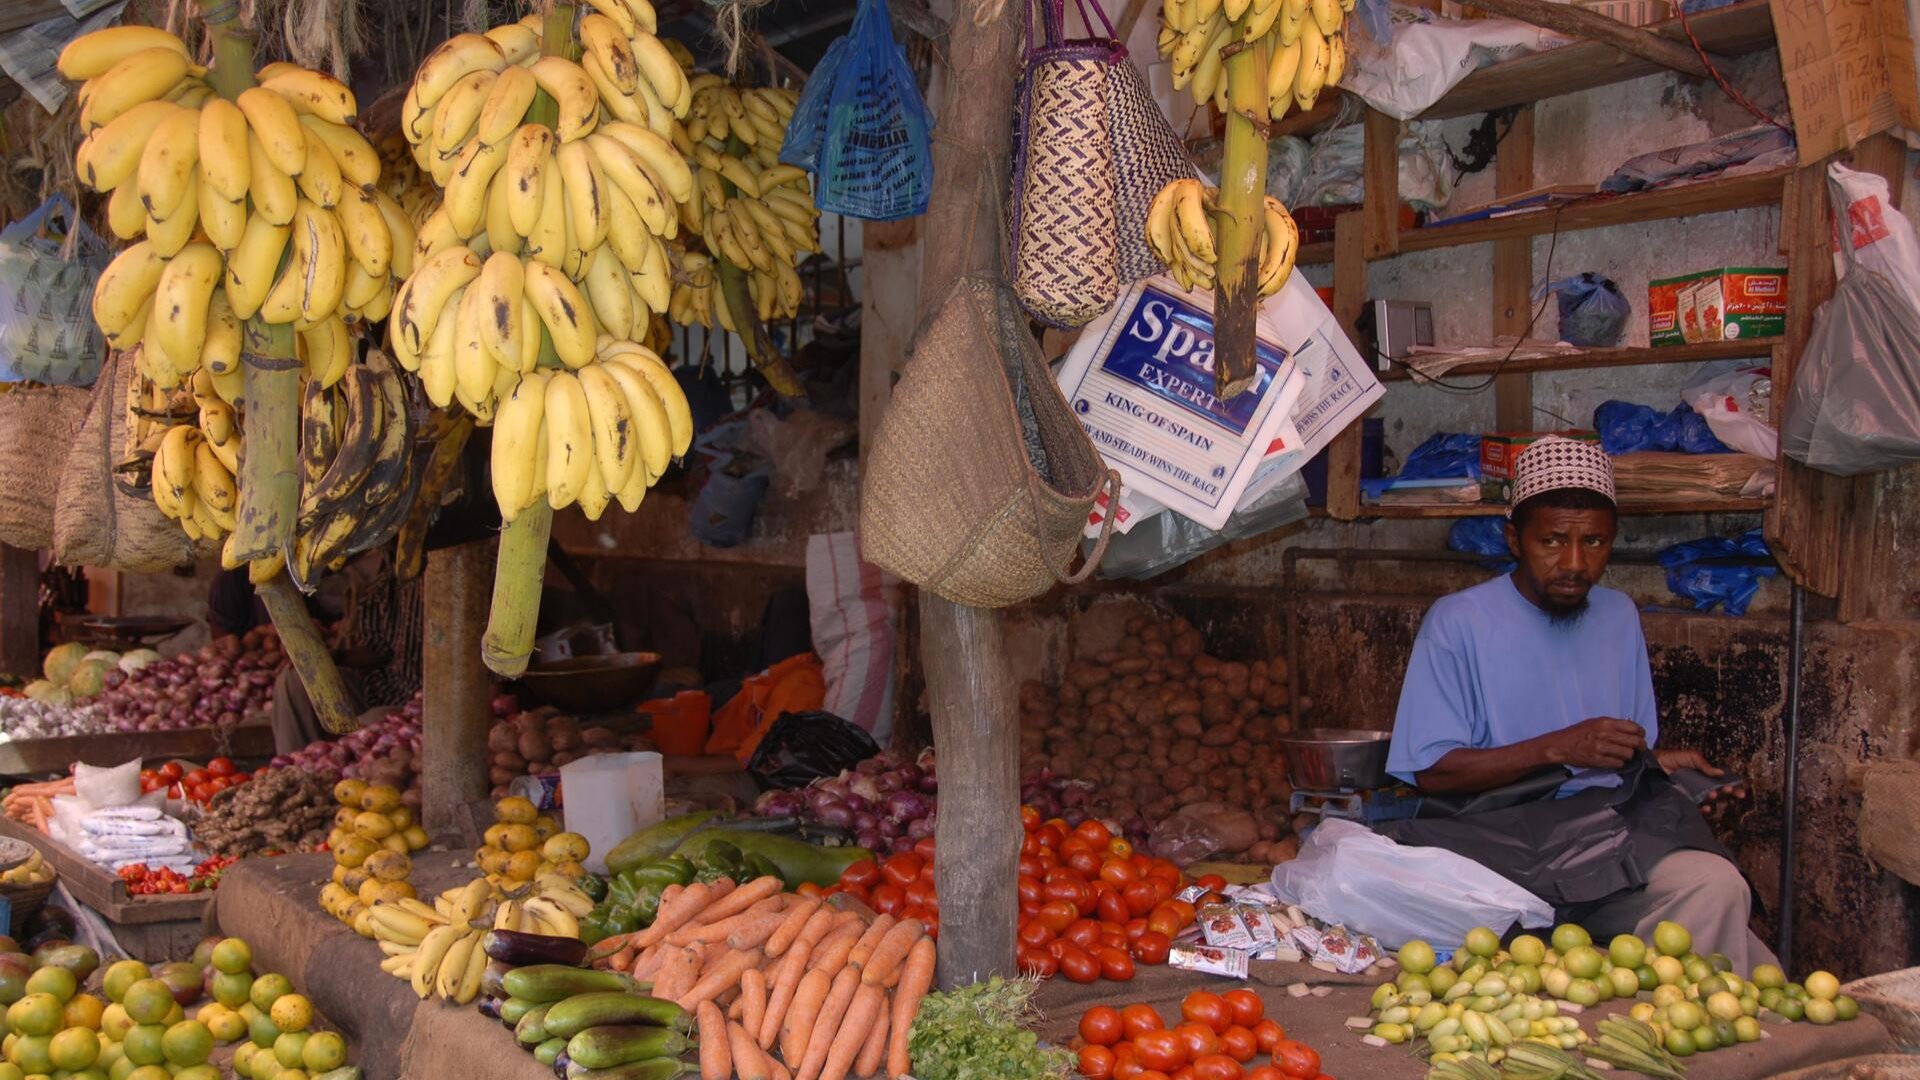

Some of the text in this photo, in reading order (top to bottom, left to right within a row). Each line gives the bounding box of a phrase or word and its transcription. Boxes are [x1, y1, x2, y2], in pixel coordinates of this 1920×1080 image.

[1137, 363, 1220, 410] EXPERT
[1316, 399, 1333, 415] THE
[1331, 381, 1354, 402] RACE
[1105, 392, 1213, 451] KING OF SPAIN
[1092, 428, 1112, 445] AND
[1111, 435, 1150, 460] STEADY
[1149, 454, 1174, 473] WINS
[1173, 466, 1194, 482] THE
[1192, 478, 1219, 496] RACE
